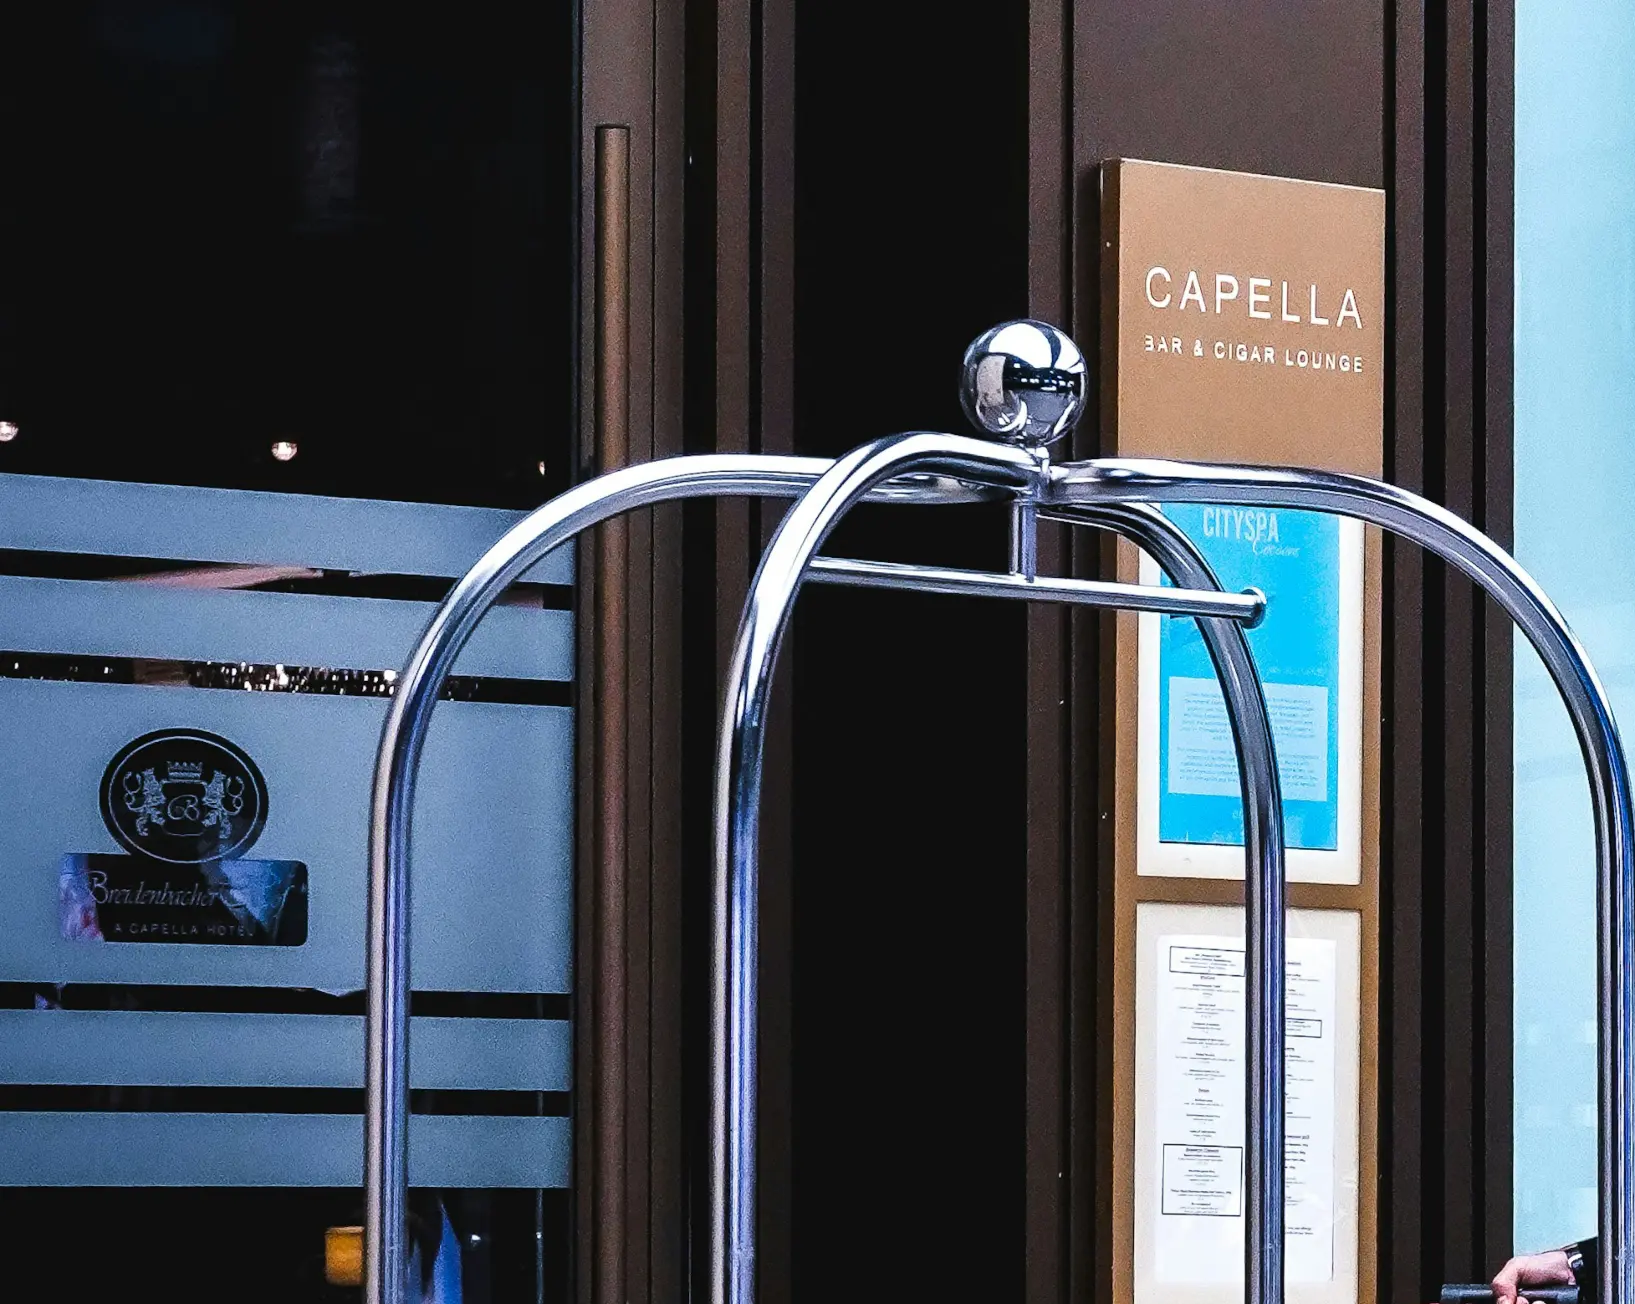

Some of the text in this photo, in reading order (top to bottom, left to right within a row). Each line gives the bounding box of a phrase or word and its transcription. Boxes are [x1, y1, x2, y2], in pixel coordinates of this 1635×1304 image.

[1145, 266, 1364, 329] CAPELLA
[1145, 334, 1364, 373] BAR & CIGAR LOUNGE
[1202, 507, 1280, 543] CITYSPA
[114, 922, 123, 934] A
[129, 922, 198, 935] CAPELLA
